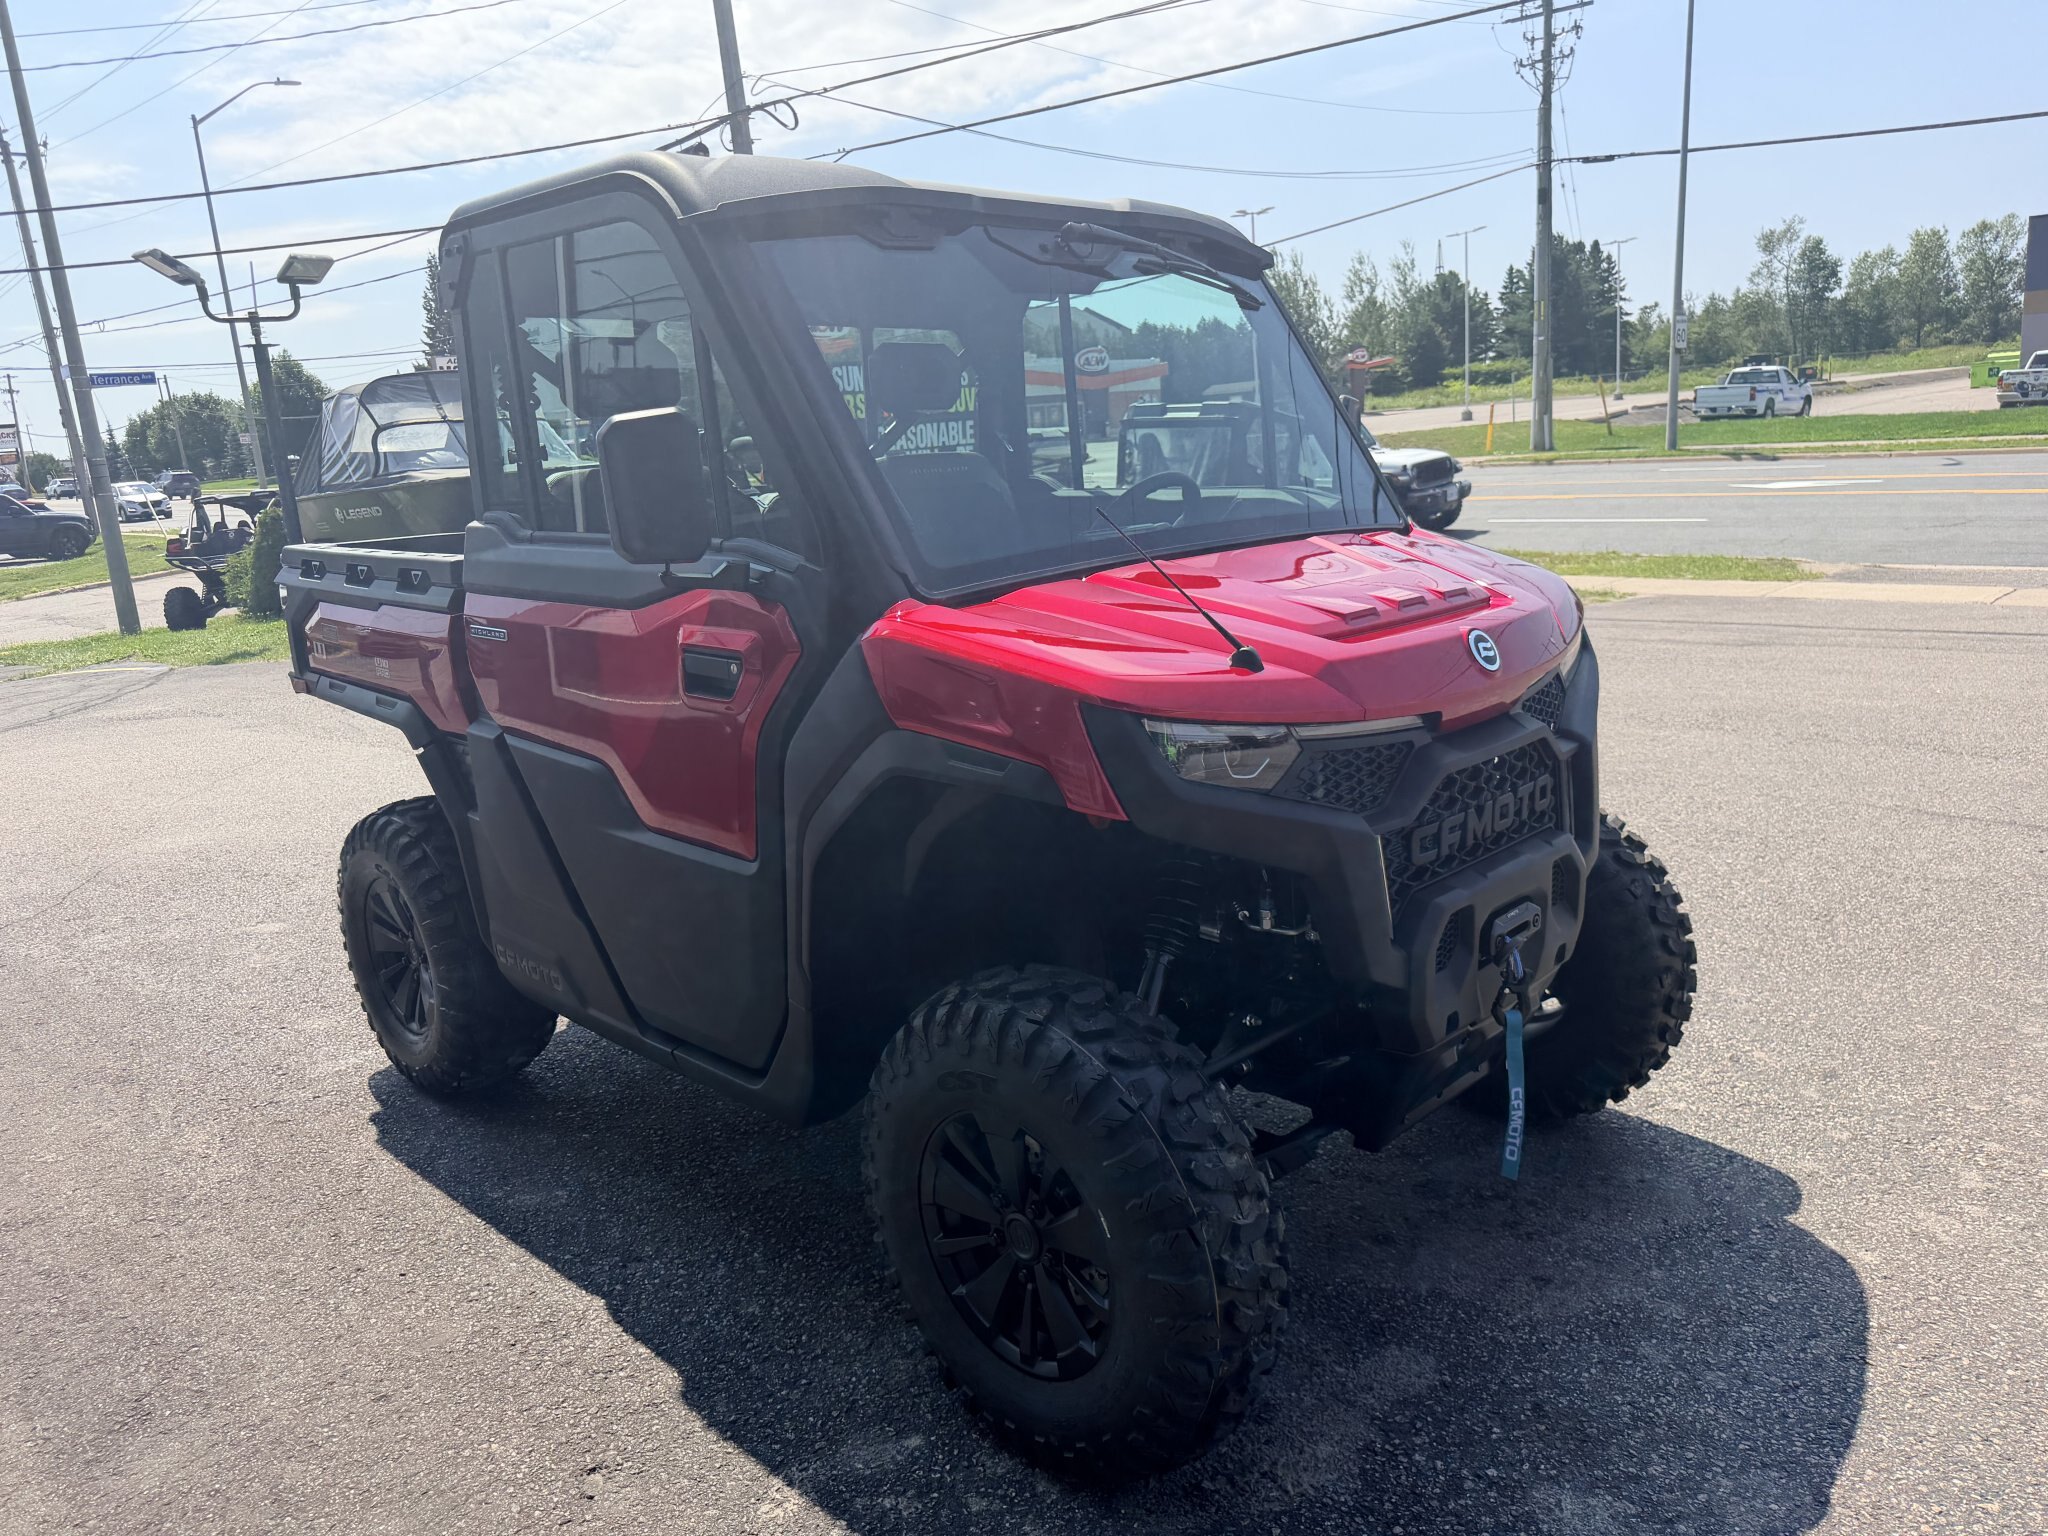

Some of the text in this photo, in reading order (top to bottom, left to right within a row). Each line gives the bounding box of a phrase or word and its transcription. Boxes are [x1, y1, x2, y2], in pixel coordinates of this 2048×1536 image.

[1676, 328, 1686, 343] 60
[92, 374, 141, 385] Terrance
[343, 506, 382, 519] LEGEND
[1411, 774, 1554, 866] CFMOTO
[496, 944, 562, 991] CFMOTO
[936, 1069, 999, 1094] CST
[1505, 1087, 1523, 1161] CFMOTO
